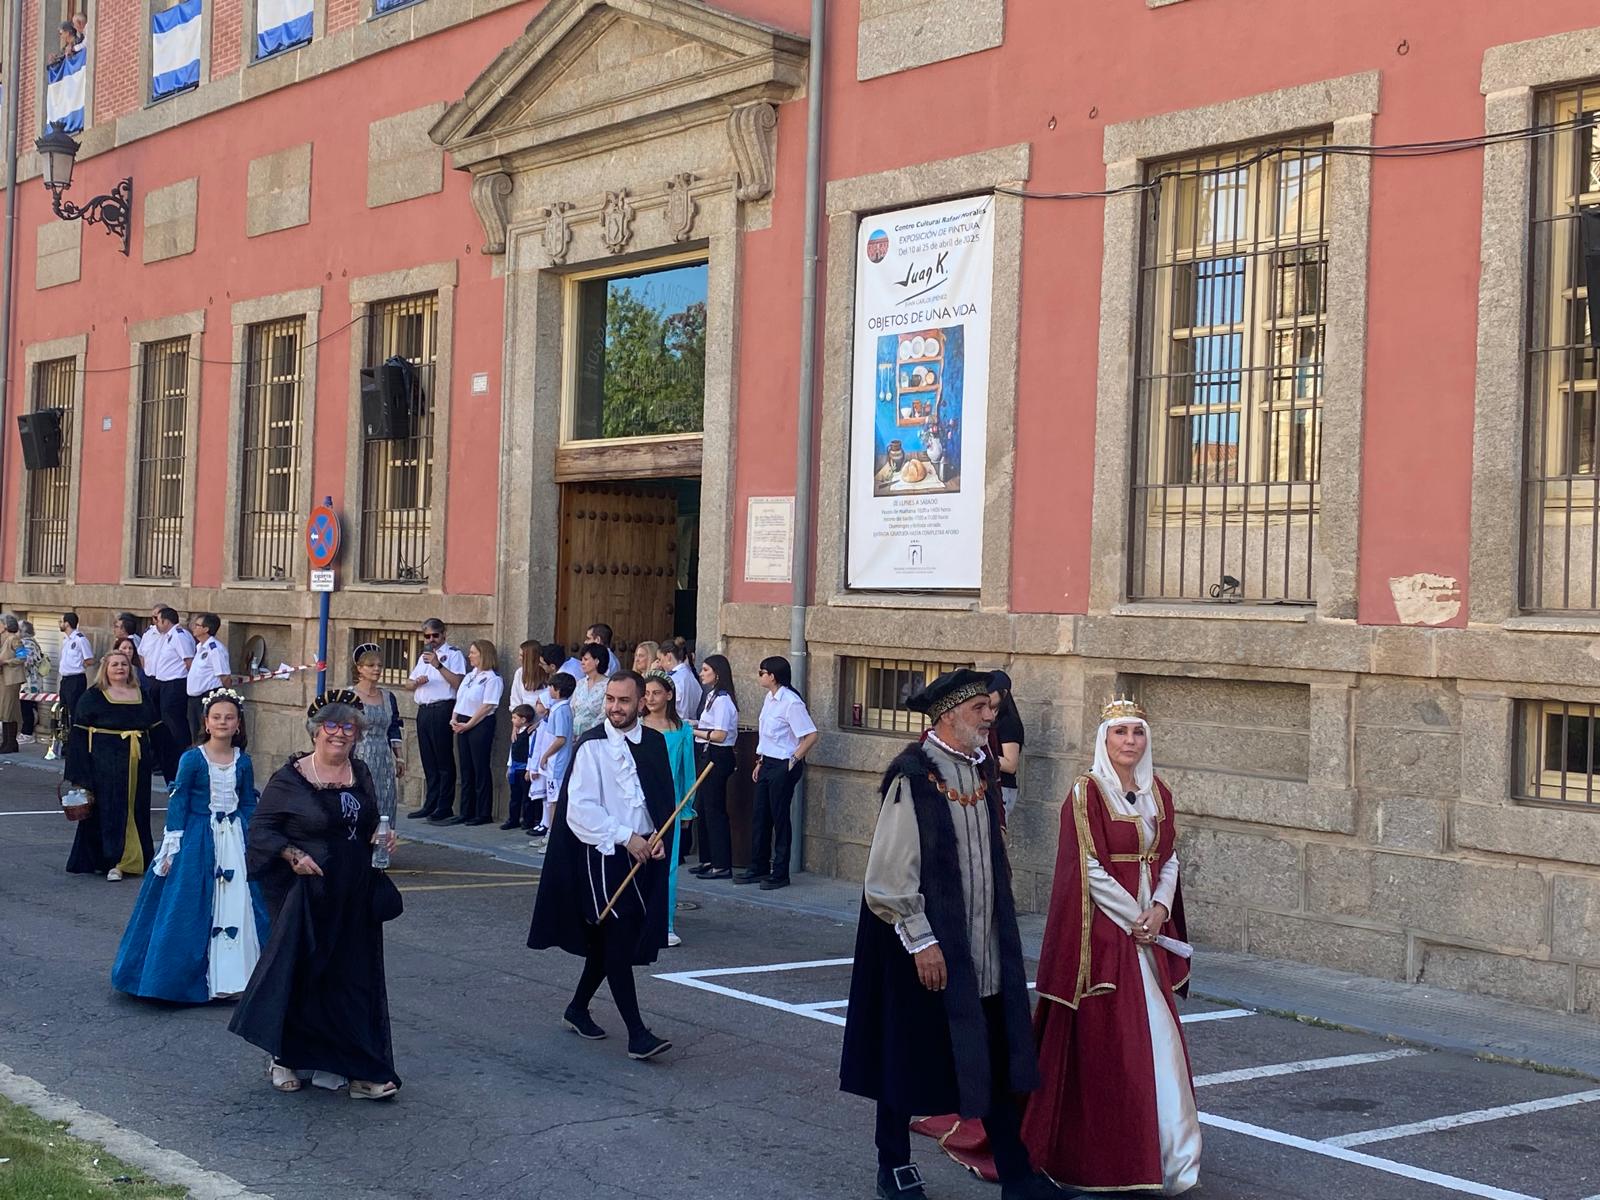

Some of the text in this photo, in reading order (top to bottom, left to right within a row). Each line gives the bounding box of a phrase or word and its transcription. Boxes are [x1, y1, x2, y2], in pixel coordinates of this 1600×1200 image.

[894, 223, 914, 232] Centro
[916, 218, 941, 228] Cultural
[938, 227, 947, 237] DE
[948, 221, 980, 236] PINTURA
[898, 247, 907, 256] Del
[922, 244, 930, 252] 25
[930, 242, 939, 250] de
[940, 239, 953, 248] abril
[954, 238, 962, 246] de
[868, 303, 977, 331] OBJETOS DE UNA VIDA
